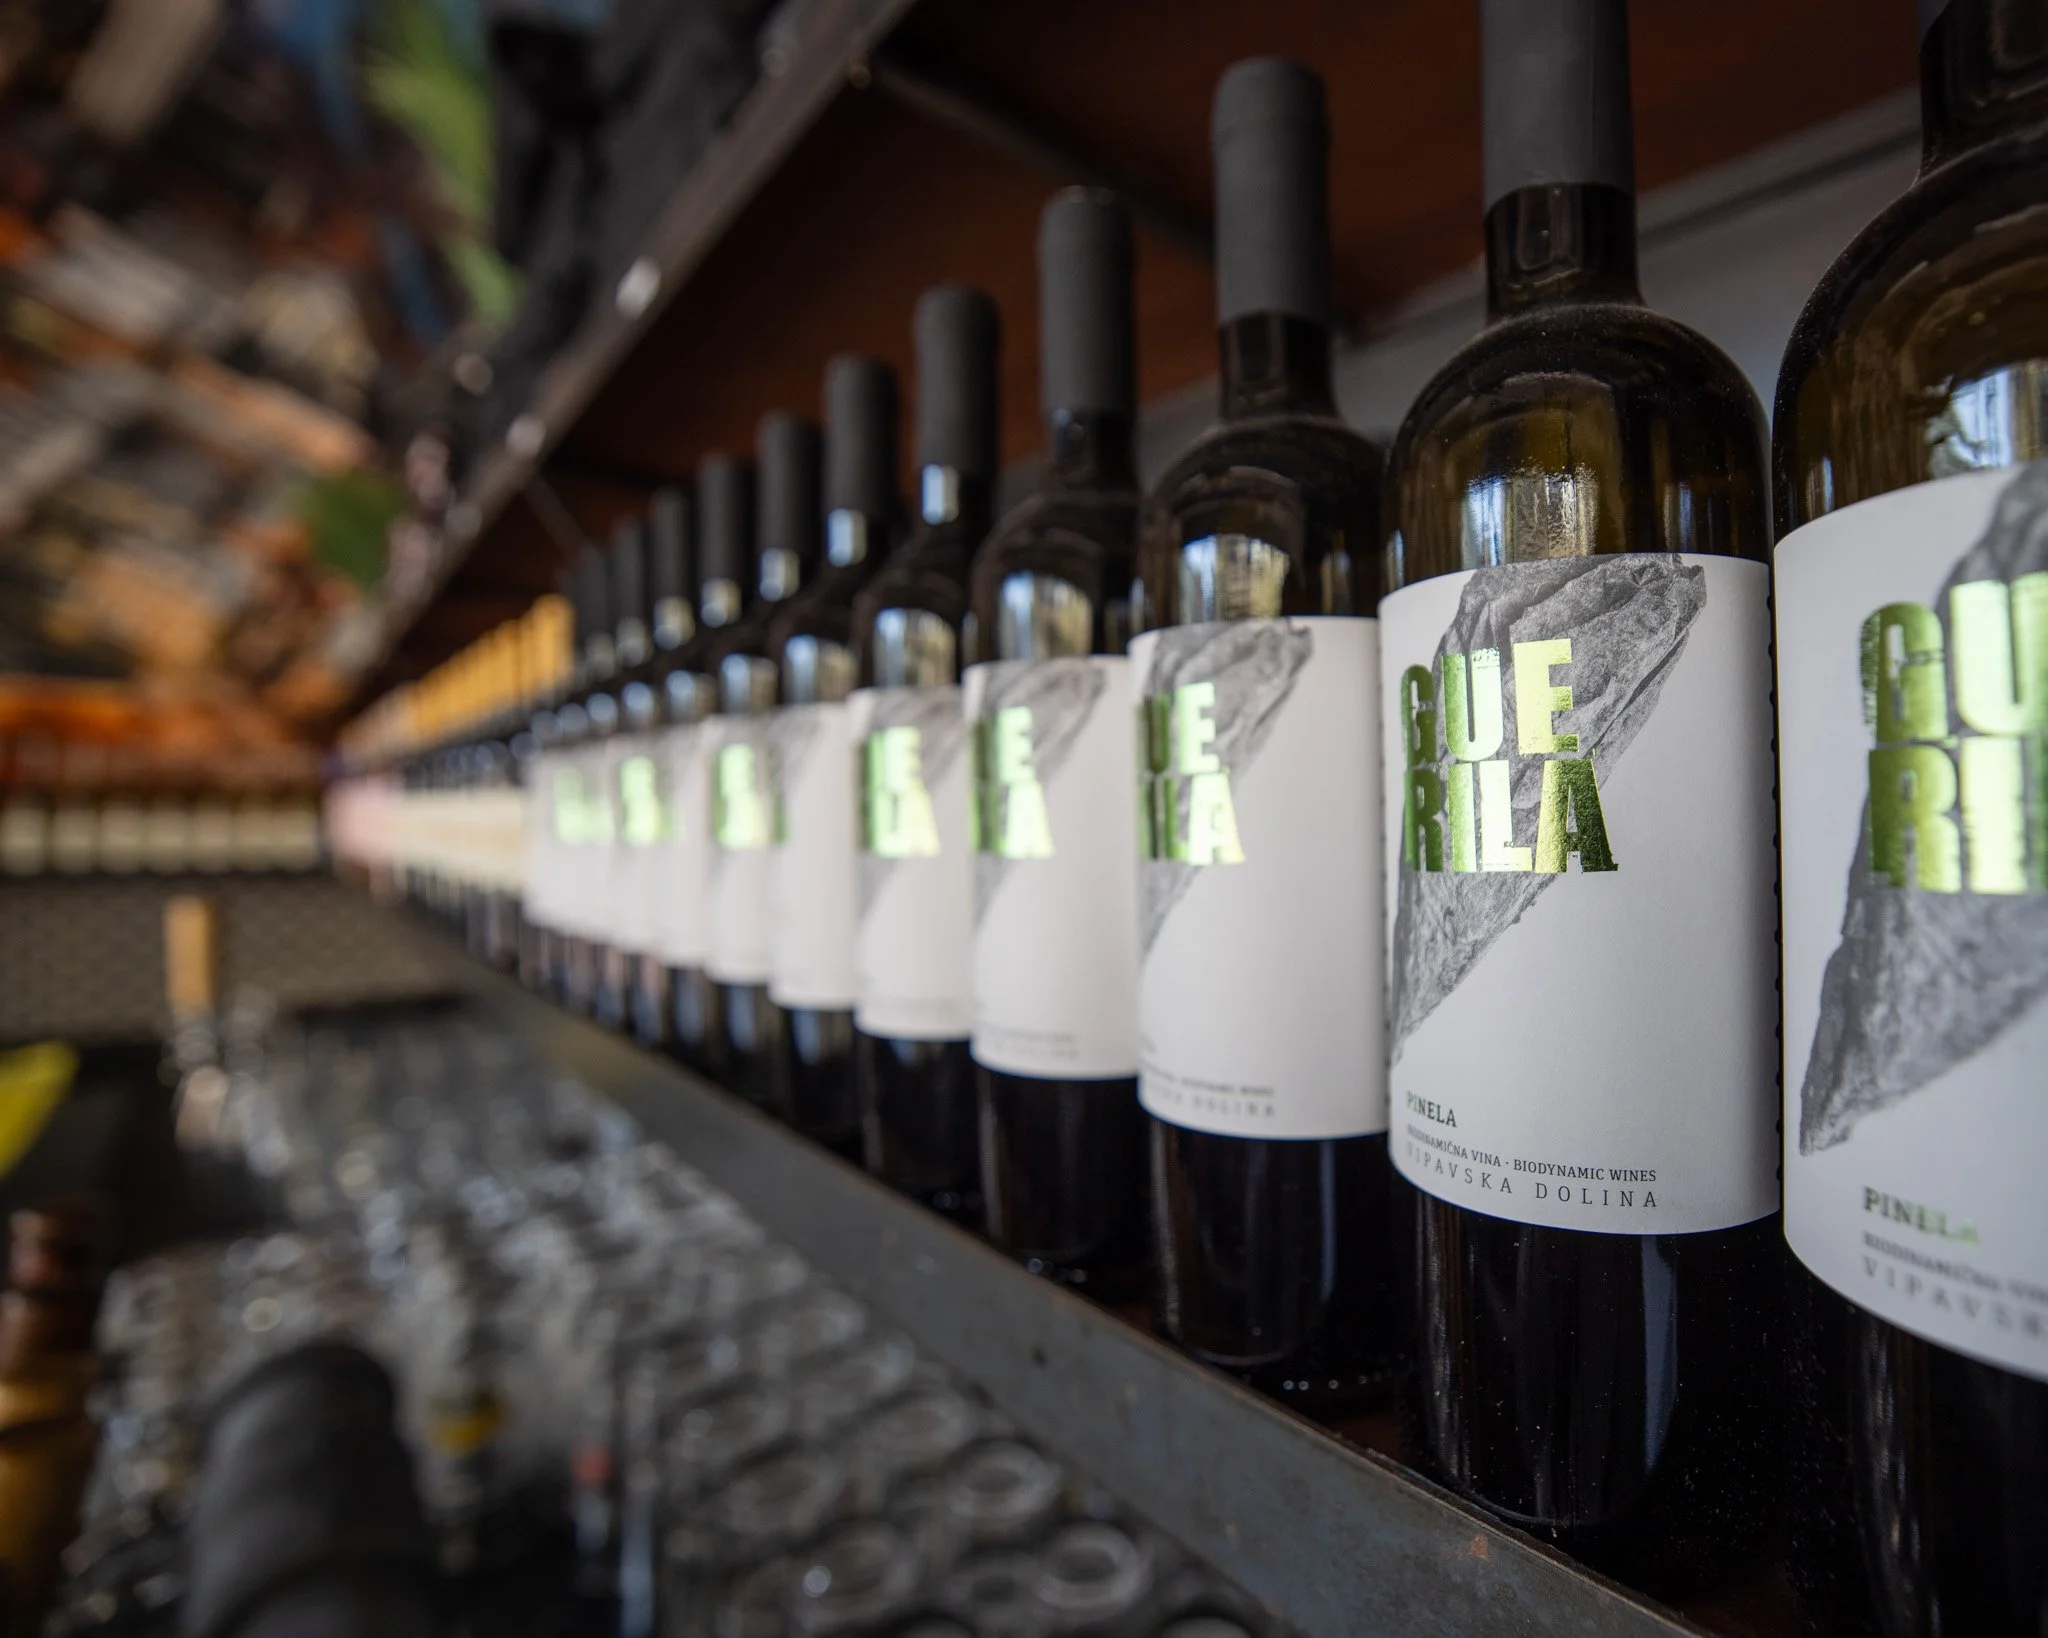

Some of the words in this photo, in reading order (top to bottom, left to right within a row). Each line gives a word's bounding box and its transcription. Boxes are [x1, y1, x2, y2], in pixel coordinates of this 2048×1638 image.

[1401, 638, 1579, 764] GUE
[1404, 749, 1618, 874] RILA
[1406, 1090, 1457, 1128] PINELA
[1406, 1141, 1512, 1194] VIPAVSKA
[1535, 1182, 1657, 1208] DOLINA
[1471, 1149, 1501, 1167] VINA
[1514, 1158, 1605, 1181] BIODYNAMIC
[1609, 1168, 1657, 1182] WINES
[1864, 1185, 1981, 1245] PINELA
